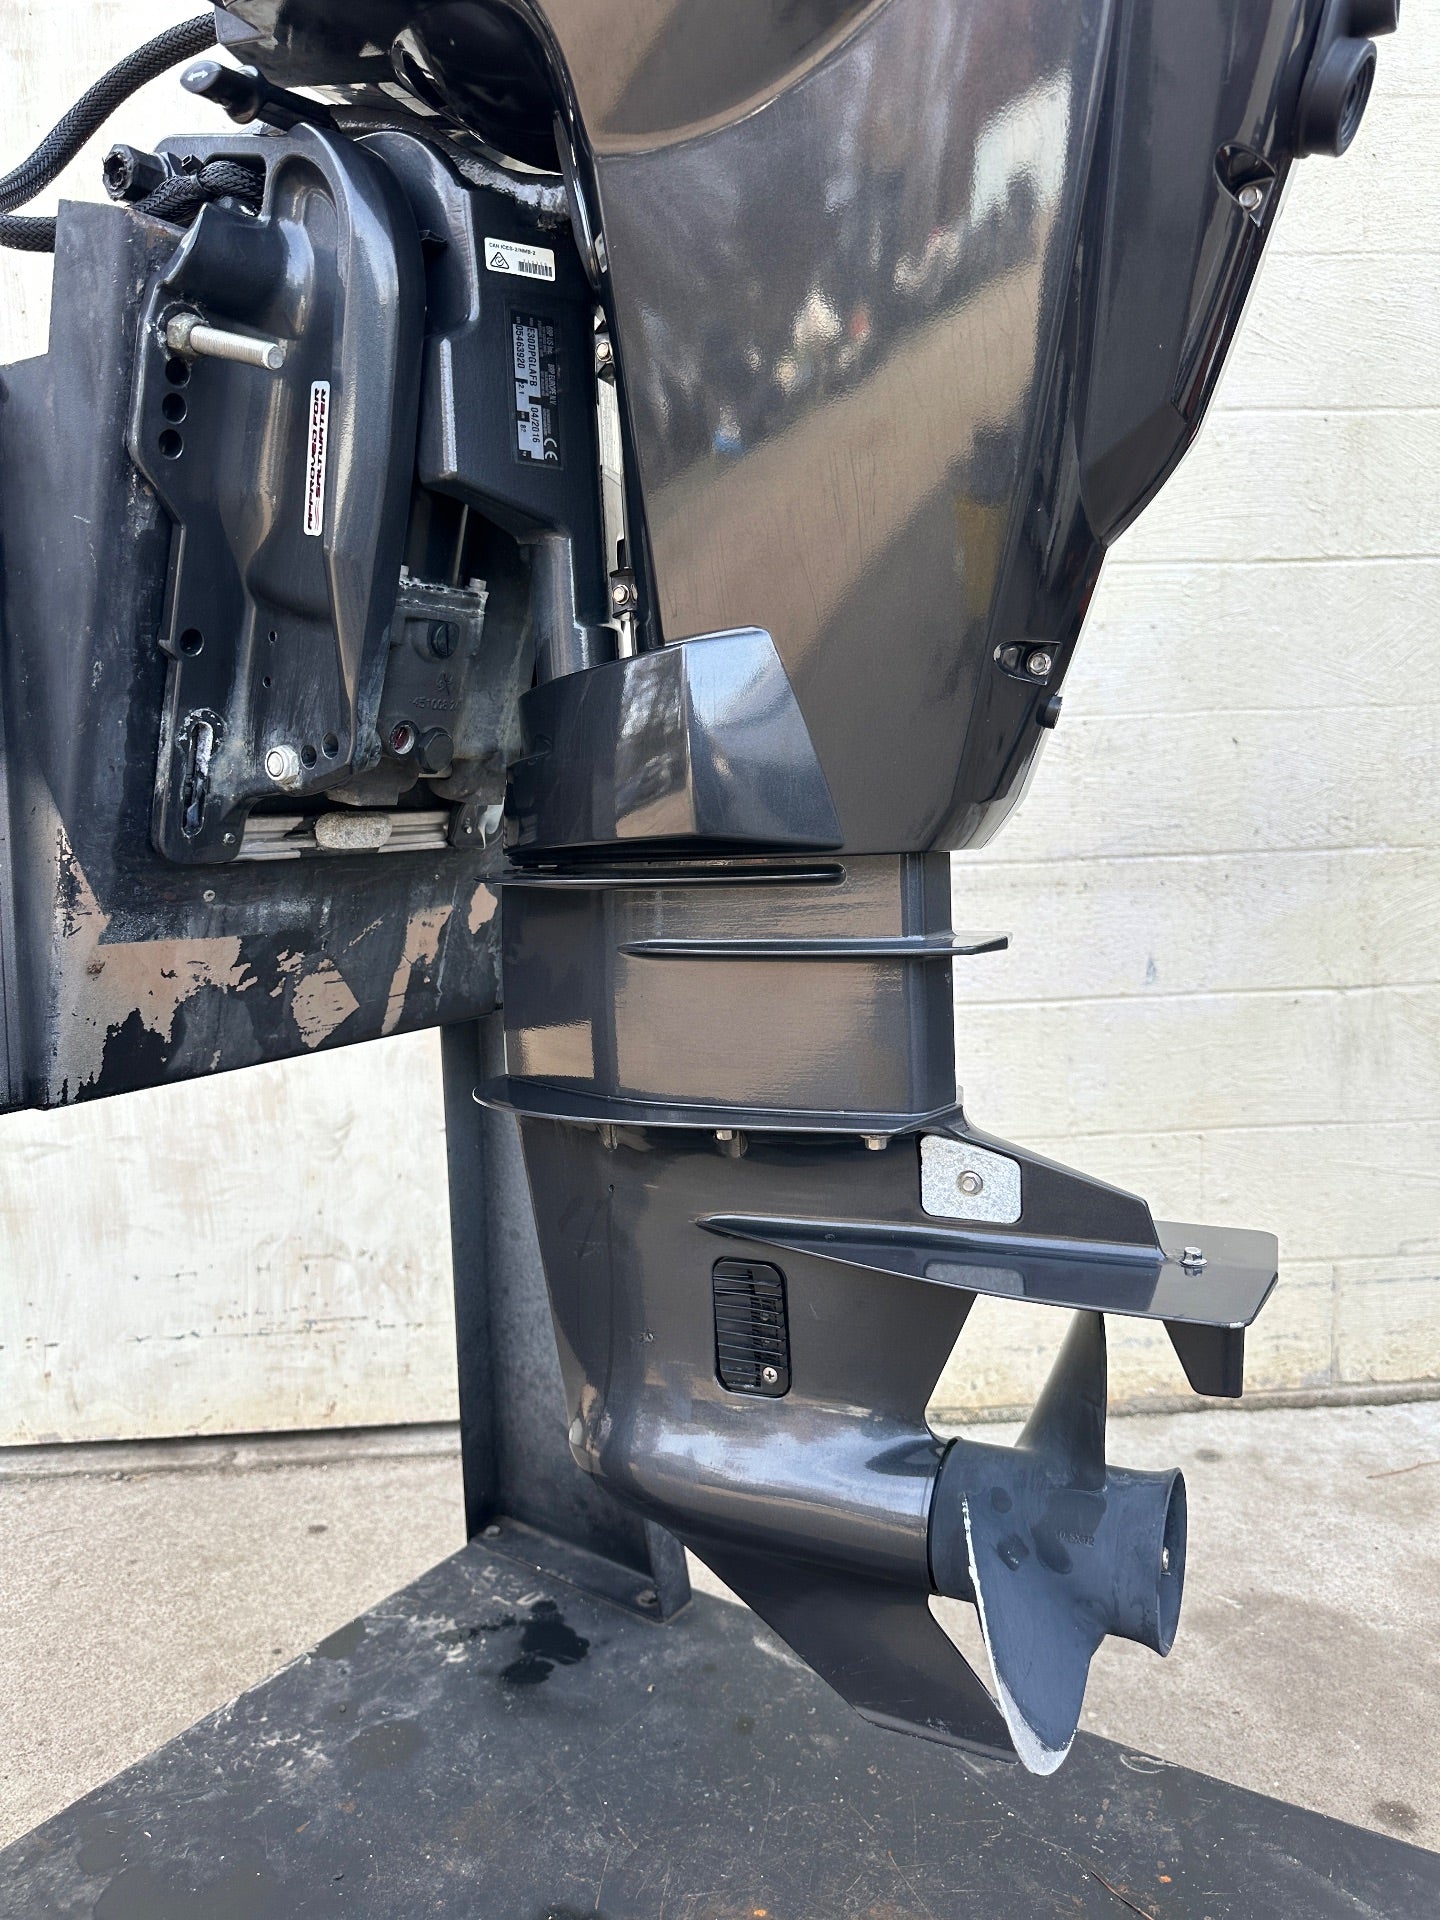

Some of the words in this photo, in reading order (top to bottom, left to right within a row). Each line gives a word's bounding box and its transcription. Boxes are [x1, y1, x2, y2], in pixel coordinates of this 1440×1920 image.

[515, 325, 525, 369] 05463920
[527, 327, 538, 387] E30DPGLAFB
[316, 388, 326, 498] SALTWATER
[531, 406, 541, 444] 04/2016
[308, 429, 317, 530] APPROVED
